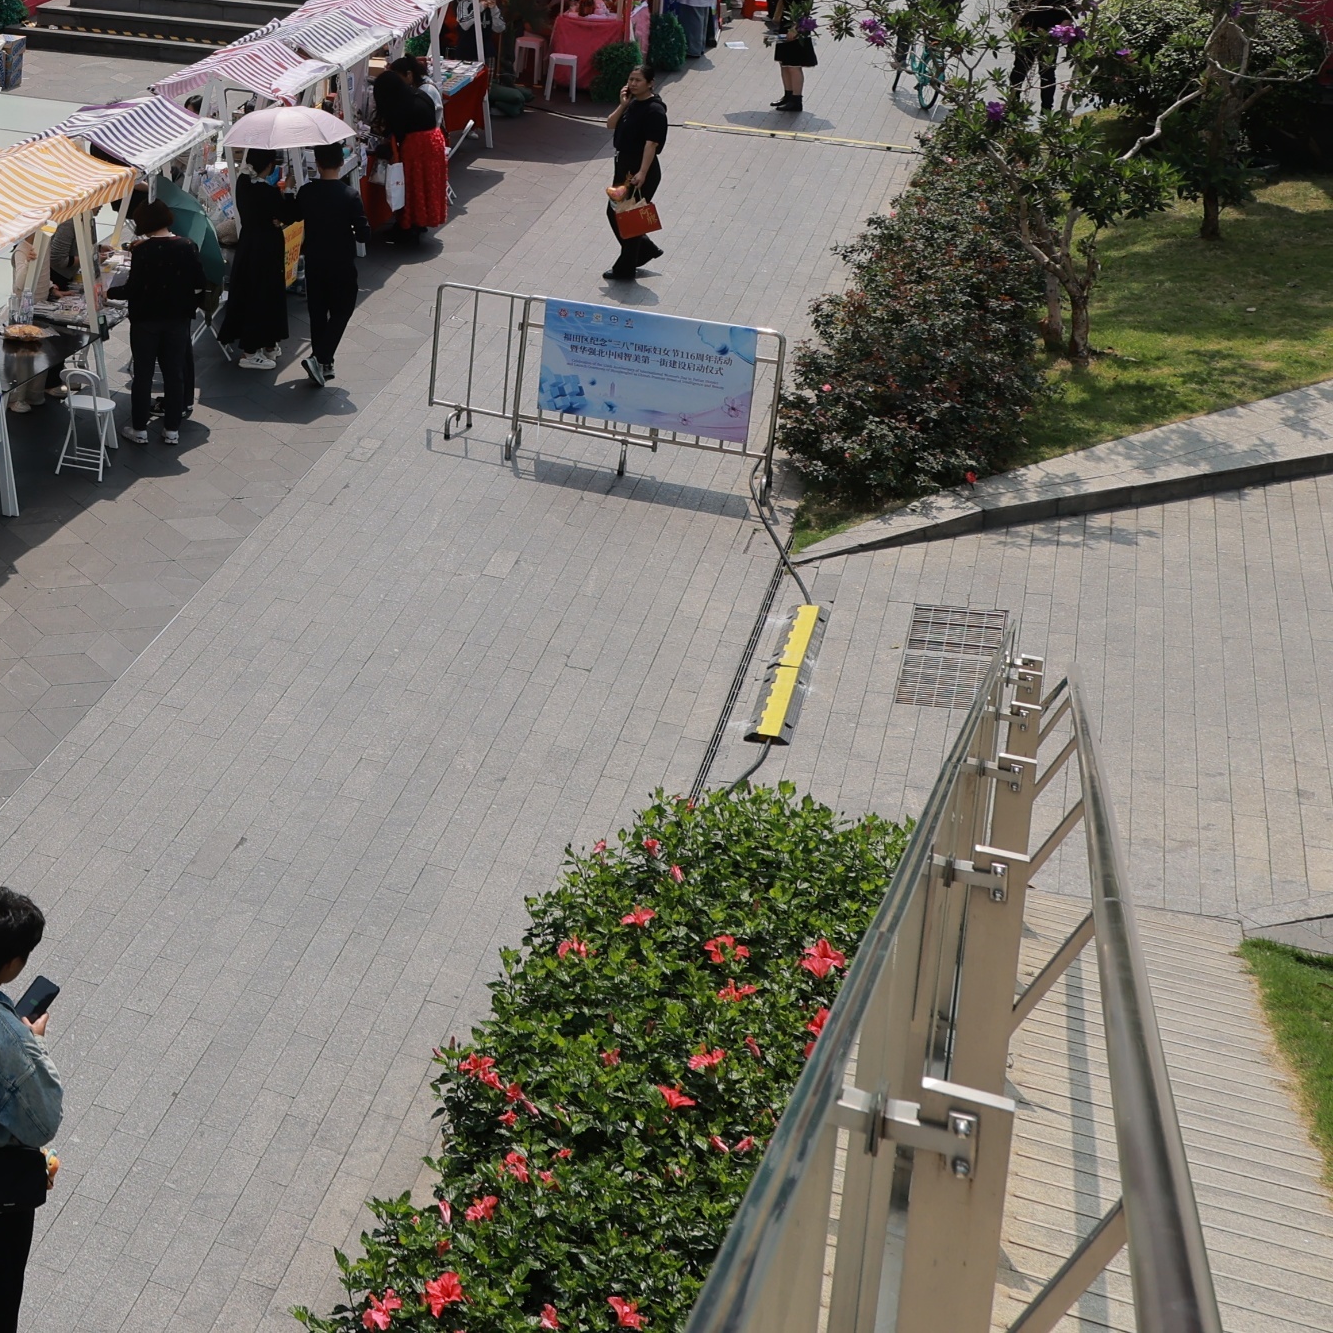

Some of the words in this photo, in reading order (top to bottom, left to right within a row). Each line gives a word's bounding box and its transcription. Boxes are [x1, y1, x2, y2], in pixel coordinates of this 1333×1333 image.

[569, 344, 724, 376] 暨华强北中国智美第一街建设启动仪式
